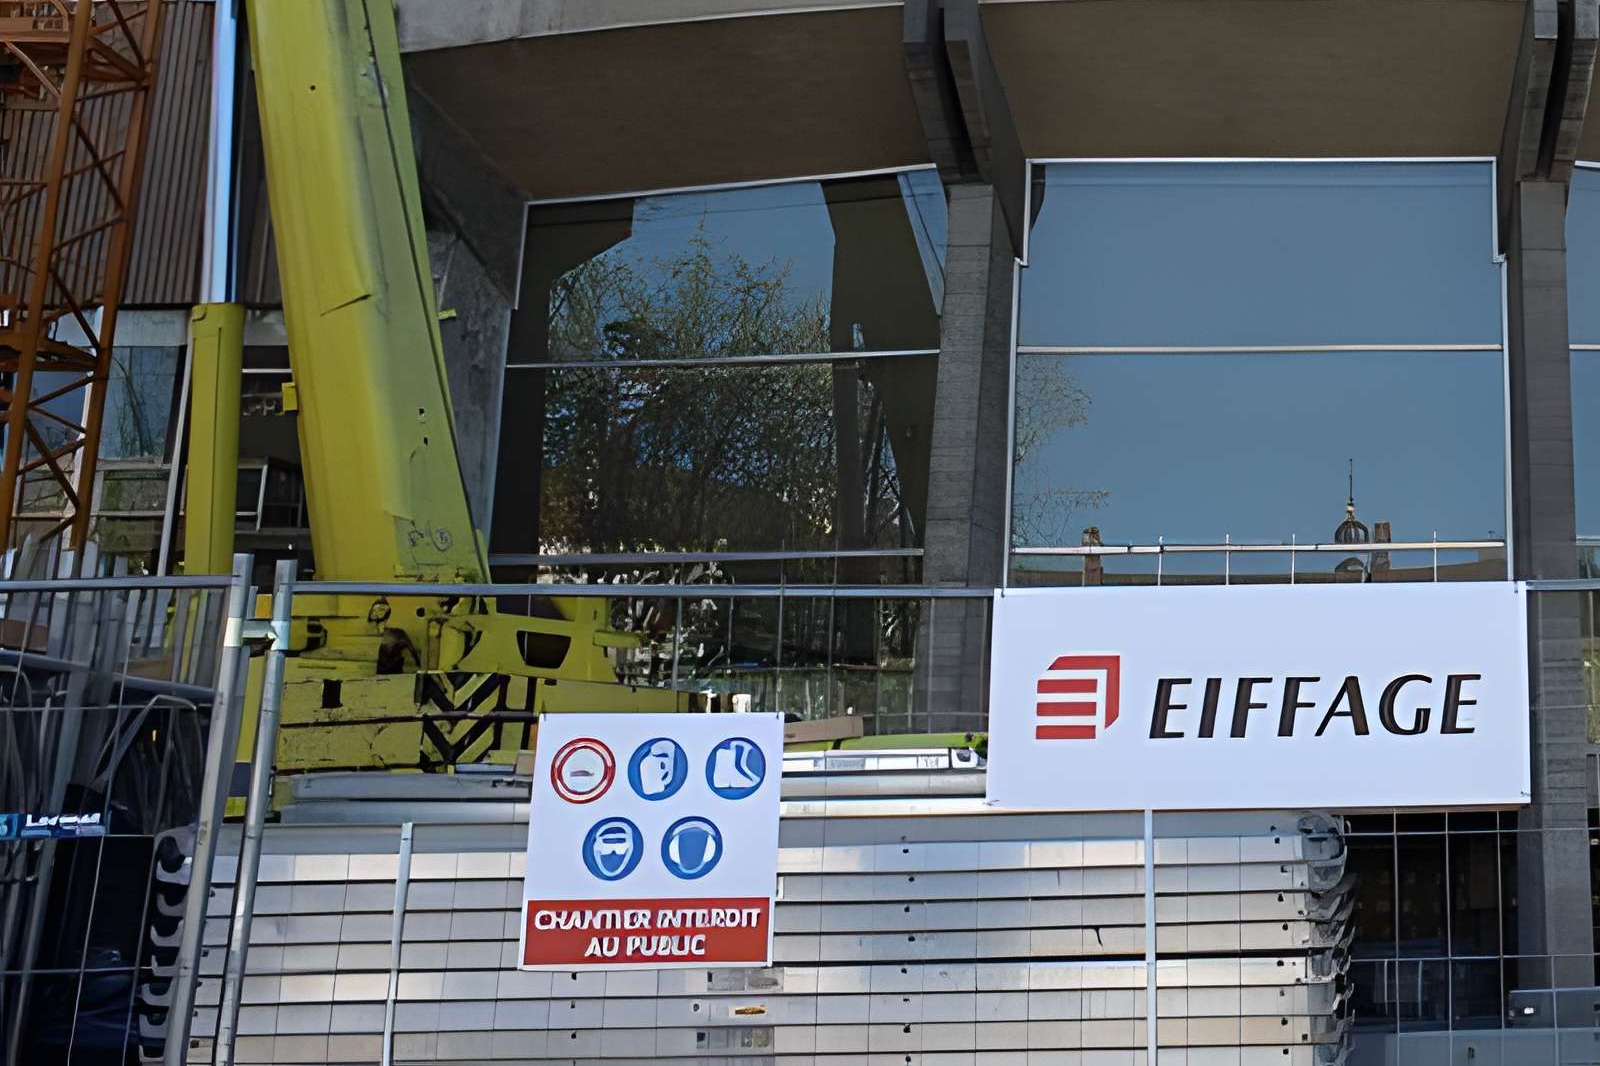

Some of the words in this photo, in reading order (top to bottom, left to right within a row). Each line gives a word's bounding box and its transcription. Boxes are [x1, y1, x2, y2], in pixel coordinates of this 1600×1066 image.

[1149, 674, 1482, 740] EIFFAGE
[534, 908, 652, 930] CHANTIER
[656, 908, 761, 929] INTERDIT
[584, 935, 620, 958] AU
[626, 934, 706, 956] PUBLIC
